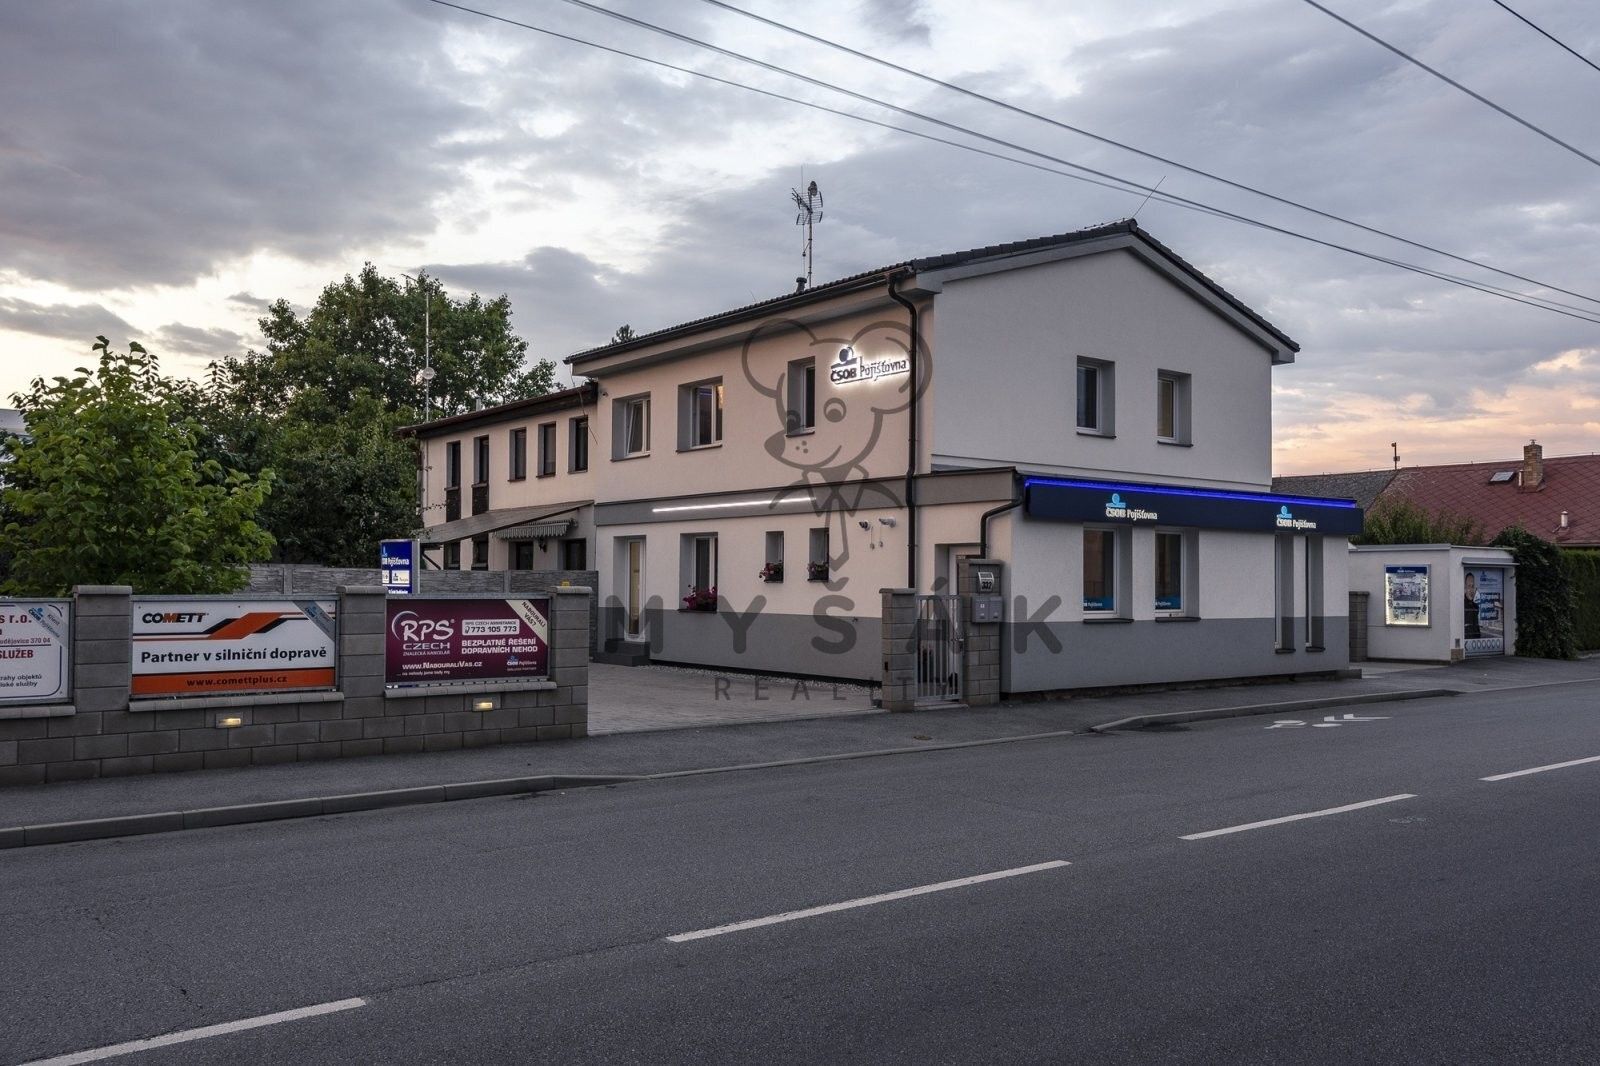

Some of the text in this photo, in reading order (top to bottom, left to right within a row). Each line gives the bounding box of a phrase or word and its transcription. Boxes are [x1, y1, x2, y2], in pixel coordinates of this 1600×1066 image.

[831, 359, 907, 382] ČSOB Pojišťovna
[1105, 507, 1158, 521] ČSOB Pojišťovna
[142, 612, 206, 624] COMETT
[401, 619, 454, 641] RPS
[402, 642, 451, 651] CZECH
[461, 637, 537, 647] BEZPLATNÉ ŘEŠENÍ
[141, 646, 327, 663] Partner v silniční dopravě
[461, 646, 510, 655] DOPRAVNÍCH
[187, 675, 288, 687] www.comettplus.cz
